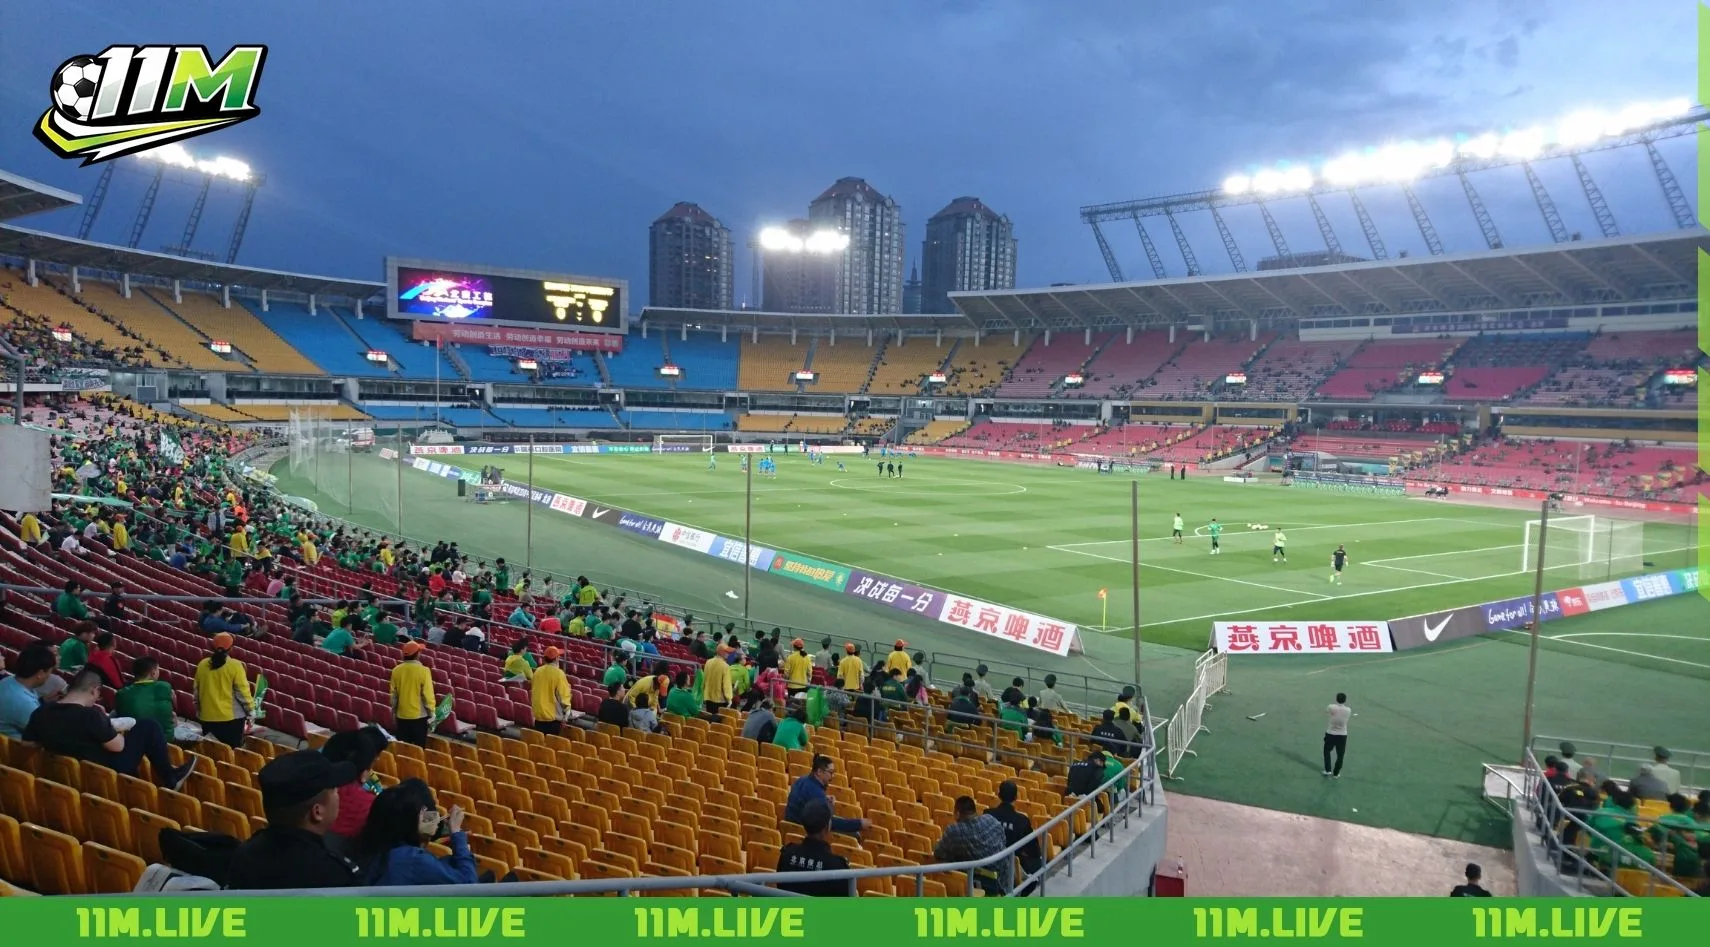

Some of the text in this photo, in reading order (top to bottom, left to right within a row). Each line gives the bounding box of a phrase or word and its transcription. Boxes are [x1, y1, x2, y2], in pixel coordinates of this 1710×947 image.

[853, 576, 933, 613] 决战每一分
[947, 598, 1066, 651] 燕京啤酒
[1226, 624, 1382, 651] 燕京啤酒
